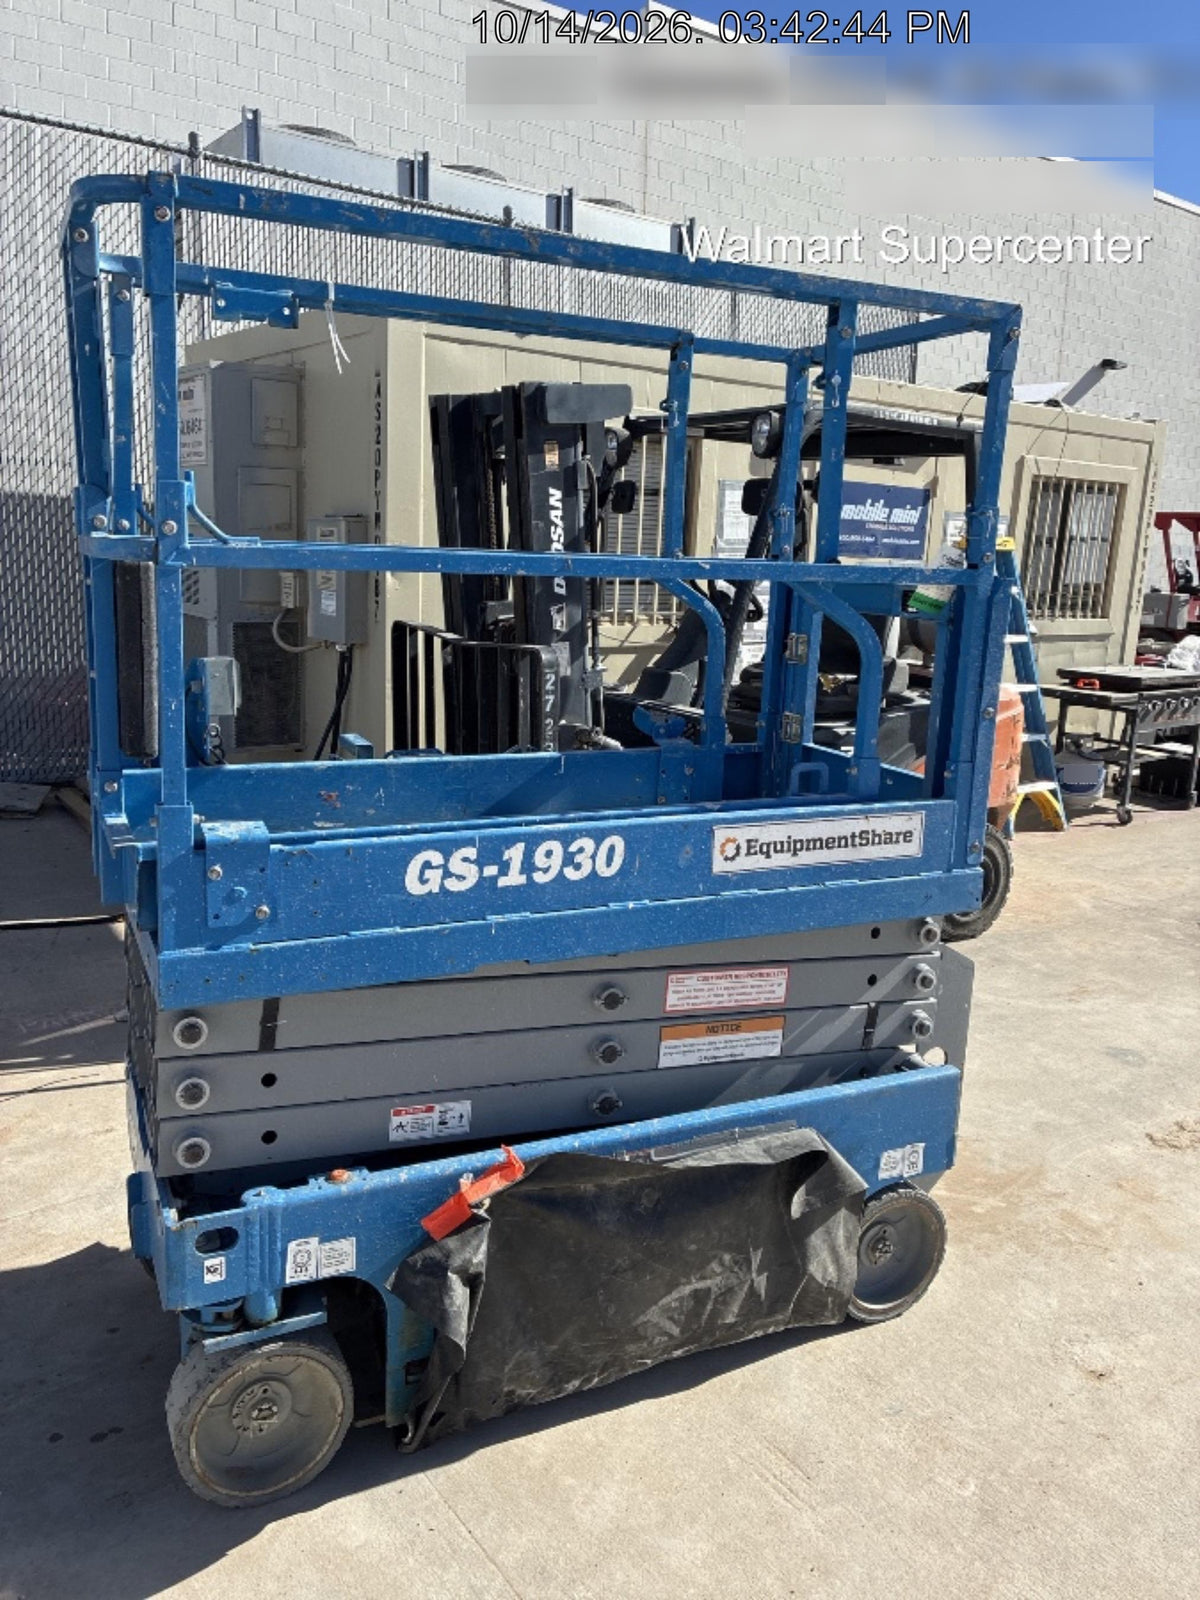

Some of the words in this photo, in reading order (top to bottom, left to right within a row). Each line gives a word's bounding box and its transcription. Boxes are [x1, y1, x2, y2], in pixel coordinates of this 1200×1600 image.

[841, 499, 889, 521] mobile
[890, 505, 922, 525] mini
[549, 486, 567, 596] DOSAN
[744, 829, 915, 859] EquipmentShare
[404, 835, 626, 896] GS-1930
[705, 1022, 742, 1034] NOTICE
